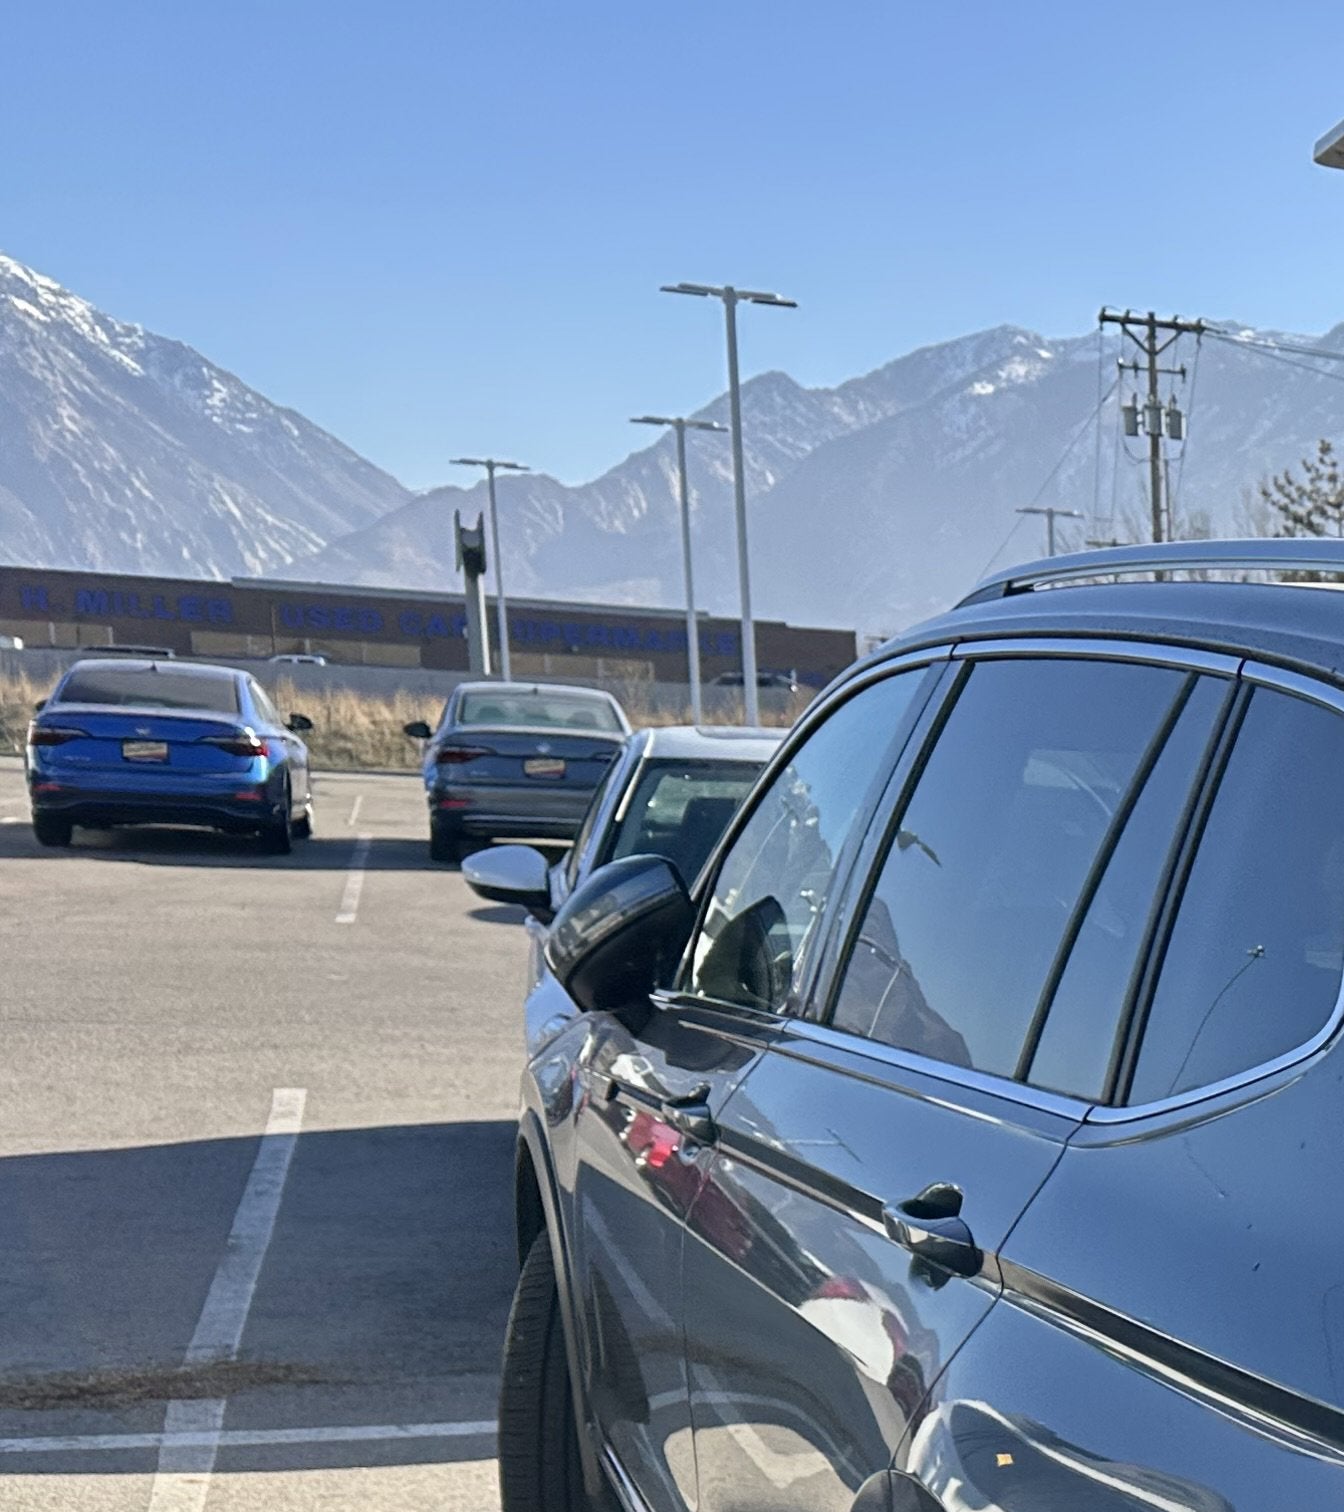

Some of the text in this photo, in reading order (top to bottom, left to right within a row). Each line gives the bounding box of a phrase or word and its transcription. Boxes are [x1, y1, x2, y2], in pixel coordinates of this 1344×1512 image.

[75, 588, 234, 623] MILLER
[279, 605, 384, 634] USED
[399, 611, 479, 641] CAR
